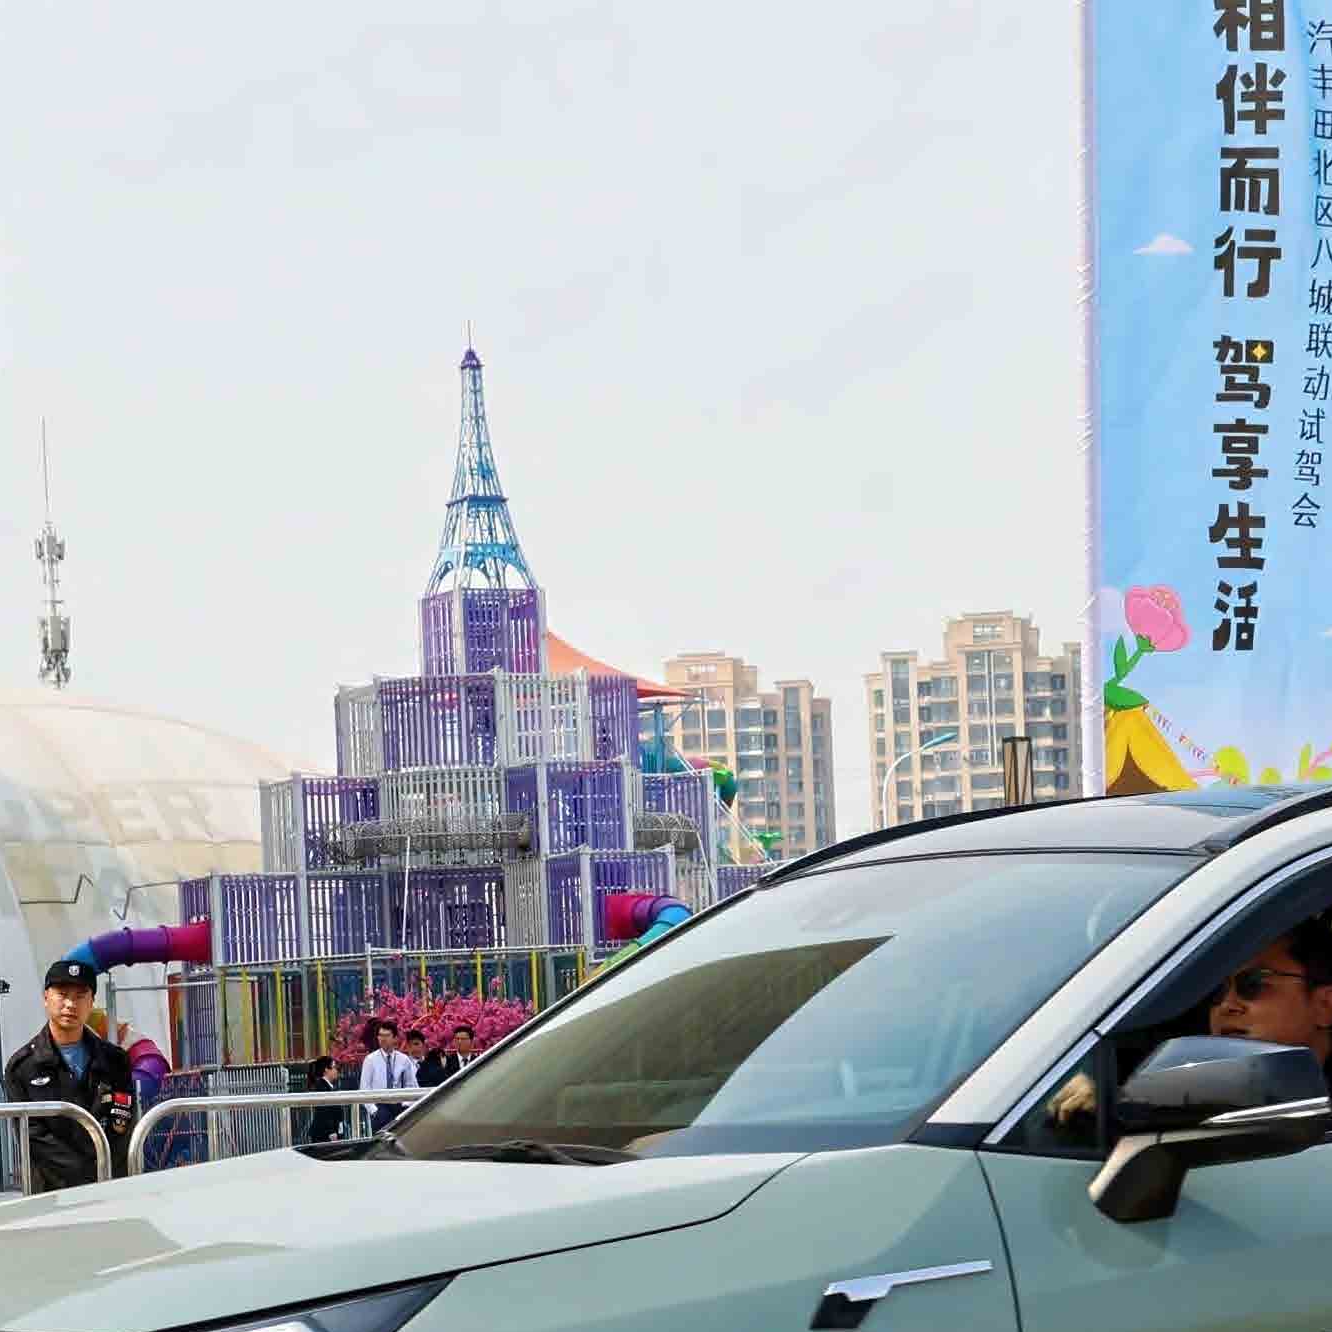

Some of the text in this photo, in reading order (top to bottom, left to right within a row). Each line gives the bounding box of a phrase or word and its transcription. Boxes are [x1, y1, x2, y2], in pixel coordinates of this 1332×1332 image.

[1208, 0, 1287, 652] 相伴而行 驾享生活
